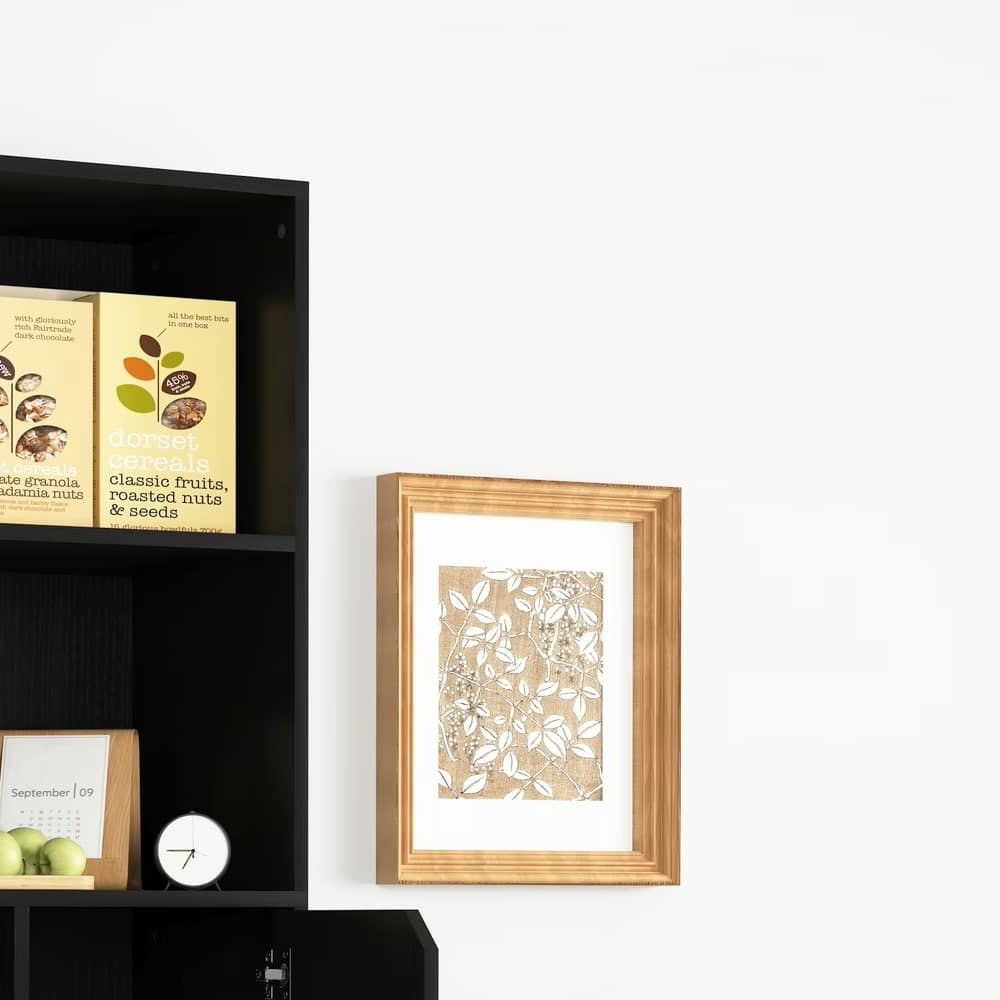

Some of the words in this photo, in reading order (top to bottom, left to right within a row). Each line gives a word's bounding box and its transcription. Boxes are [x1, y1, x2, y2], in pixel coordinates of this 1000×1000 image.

[35, 316, 76, 326] gloriously
[34, 325, 72, 333] Fairtrade
[15, 332, 34, 340] dark
[36, 334, 75, 342] chocolate
[108, 427, 200, 451] dorset
[108, 453, 210, 474] cereals
[14, 463, 77, 477] cereals
[24, 477, 80, 488] granola
[110, 473, 170, 488] classic
[174, 476, 228, 493] fruits,
[52, 489, 84, 500] nuts
[109, 490, 176, 504] roasted
[182, 493, 222, 506] nuts
[110, 504, 124, 516] &
[130, 506, 178, 519] seeds
[11, 788, 70, 799] September
[80, 788, 94, 798] 09
